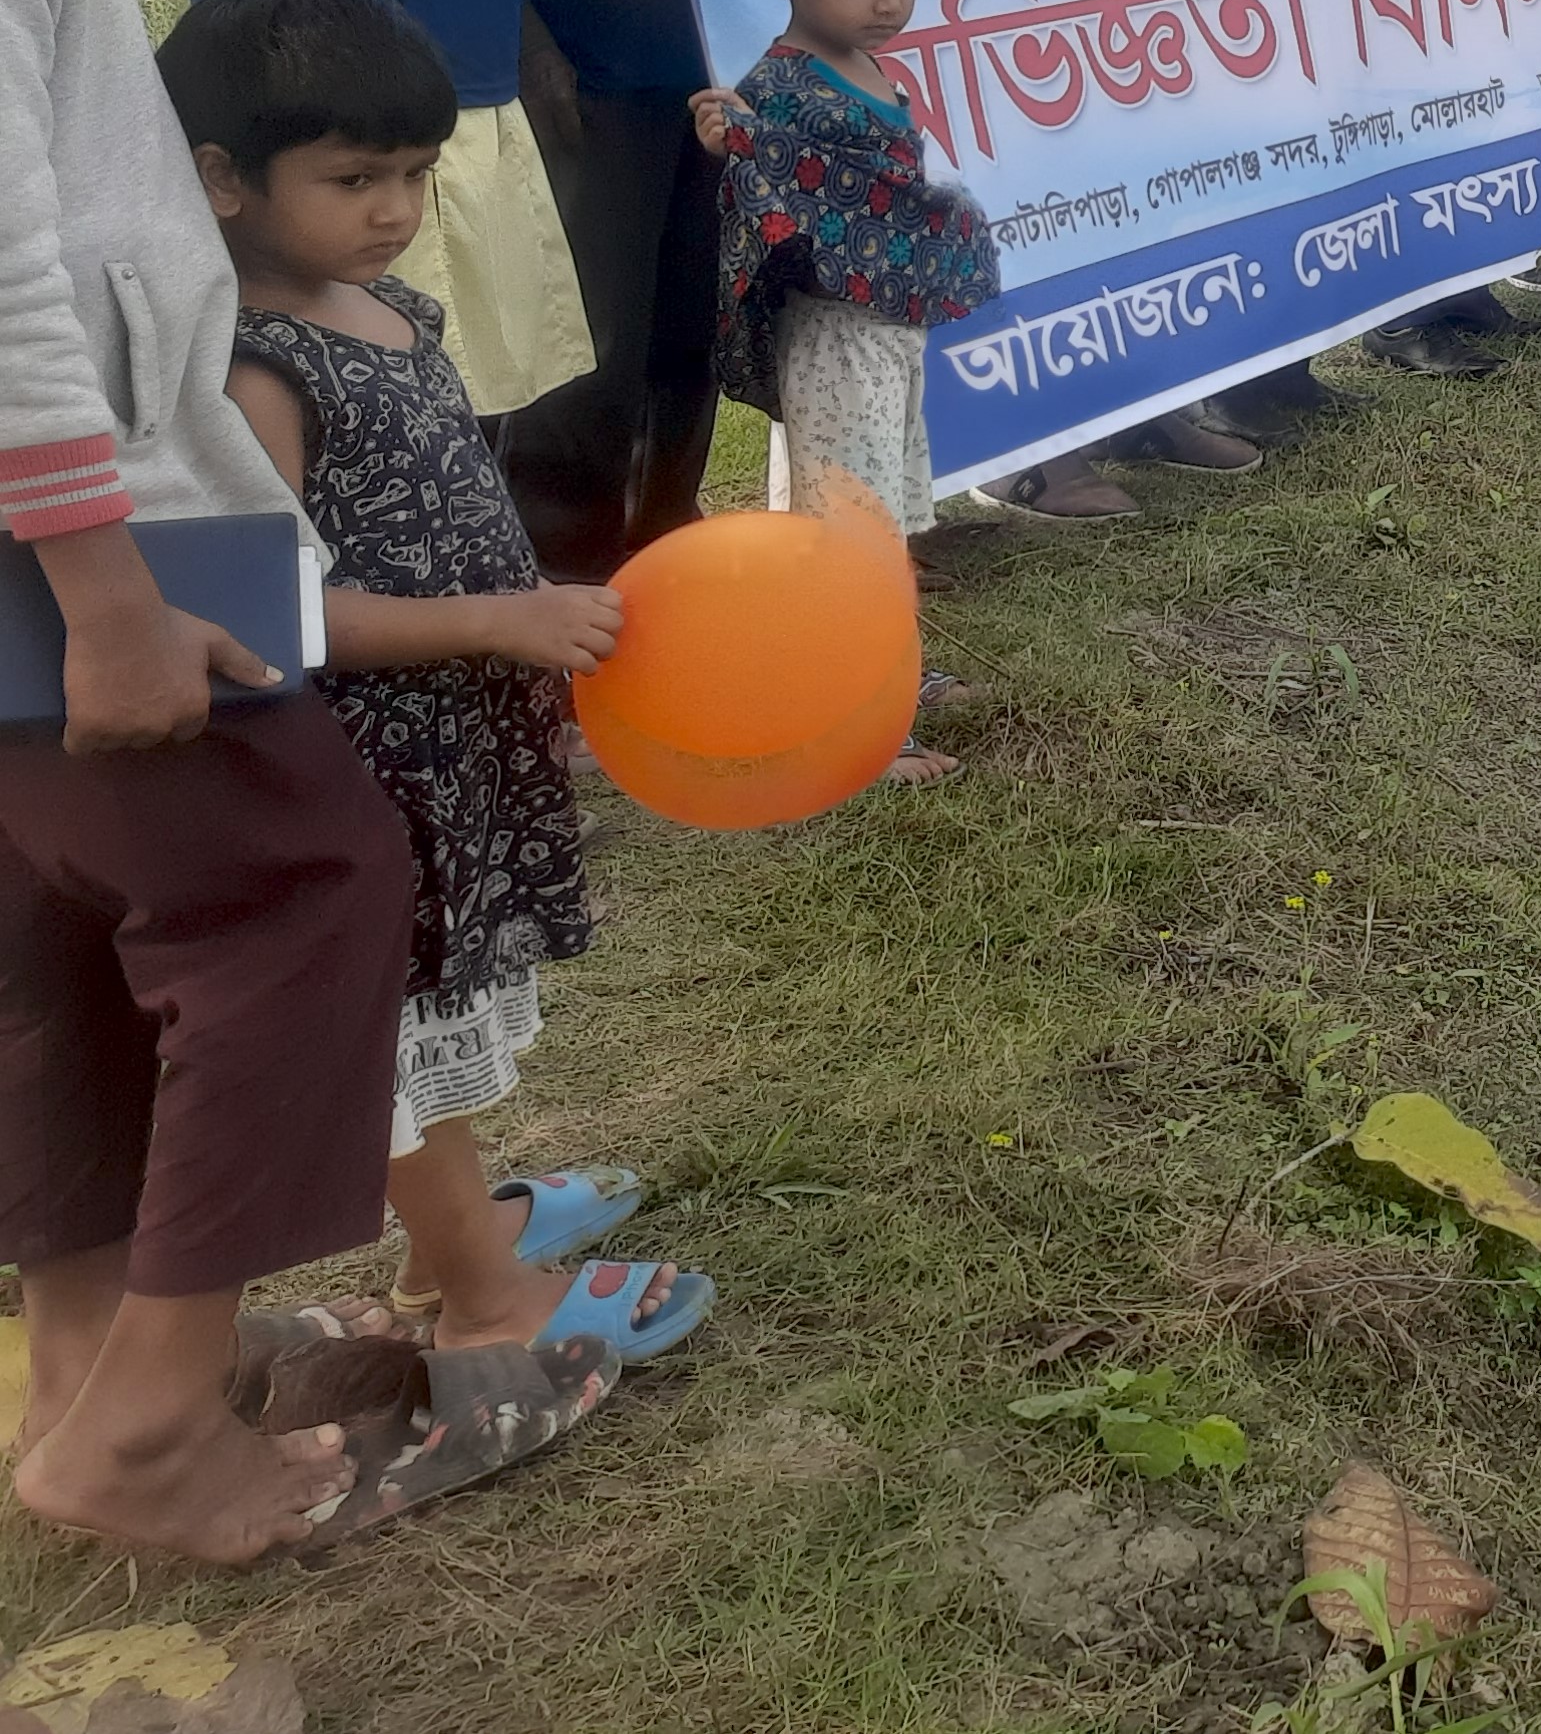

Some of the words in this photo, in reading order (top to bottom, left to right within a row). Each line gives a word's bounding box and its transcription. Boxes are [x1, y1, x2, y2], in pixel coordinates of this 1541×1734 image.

[1146, 149, 1263, 210] গোপালগঞ্জ
[1265, 134, 1329, 171] সদর,
[1327, 106, 1404, 166] টুঙ্গিপাড়া,
[1410, 75, 1506, 134] মোল্লারহাট
[940, 251, 1268, 396] আয়োজনে:
[1293, 191, 1401, 288] জেলা
[1410, 157, 1541, 237] মৎস্য
